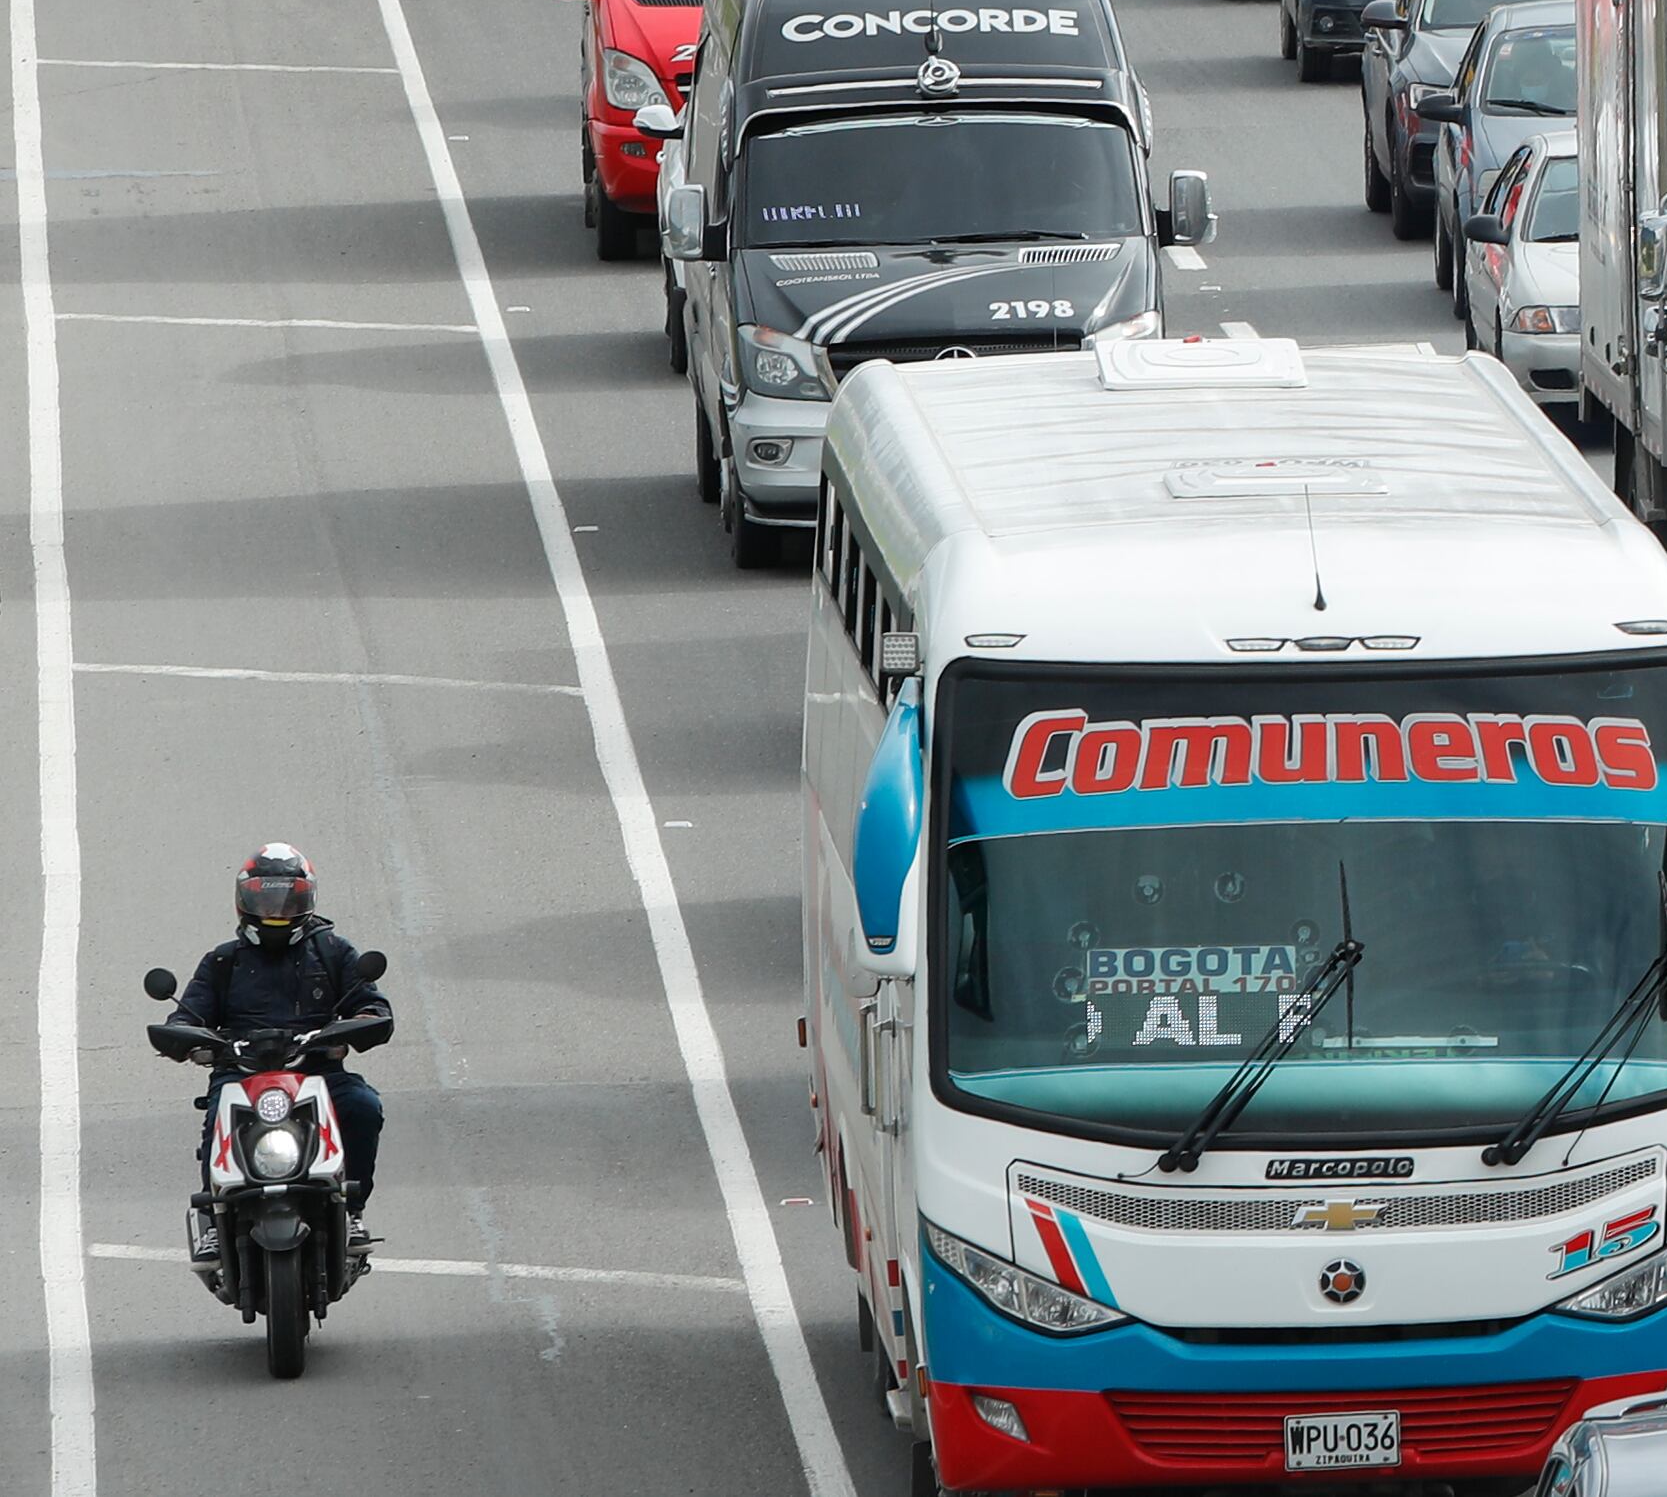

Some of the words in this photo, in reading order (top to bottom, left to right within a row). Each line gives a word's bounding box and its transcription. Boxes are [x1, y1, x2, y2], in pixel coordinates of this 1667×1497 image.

[782, 7, 1079, 43] CONCORDE
[989, 299, 1075, 321] 2198
[1001, 707, 1660, 802] Comuneros
[1089, 947, 1295, 979] BOGOTA
[1089, 977, 1221, 995] PORTAL
[1231, 976, 1297, 994] 170
[1270, 1159, 1413, 1177] Marcopolo
[1547, 1205, 1662, 1281] 15
